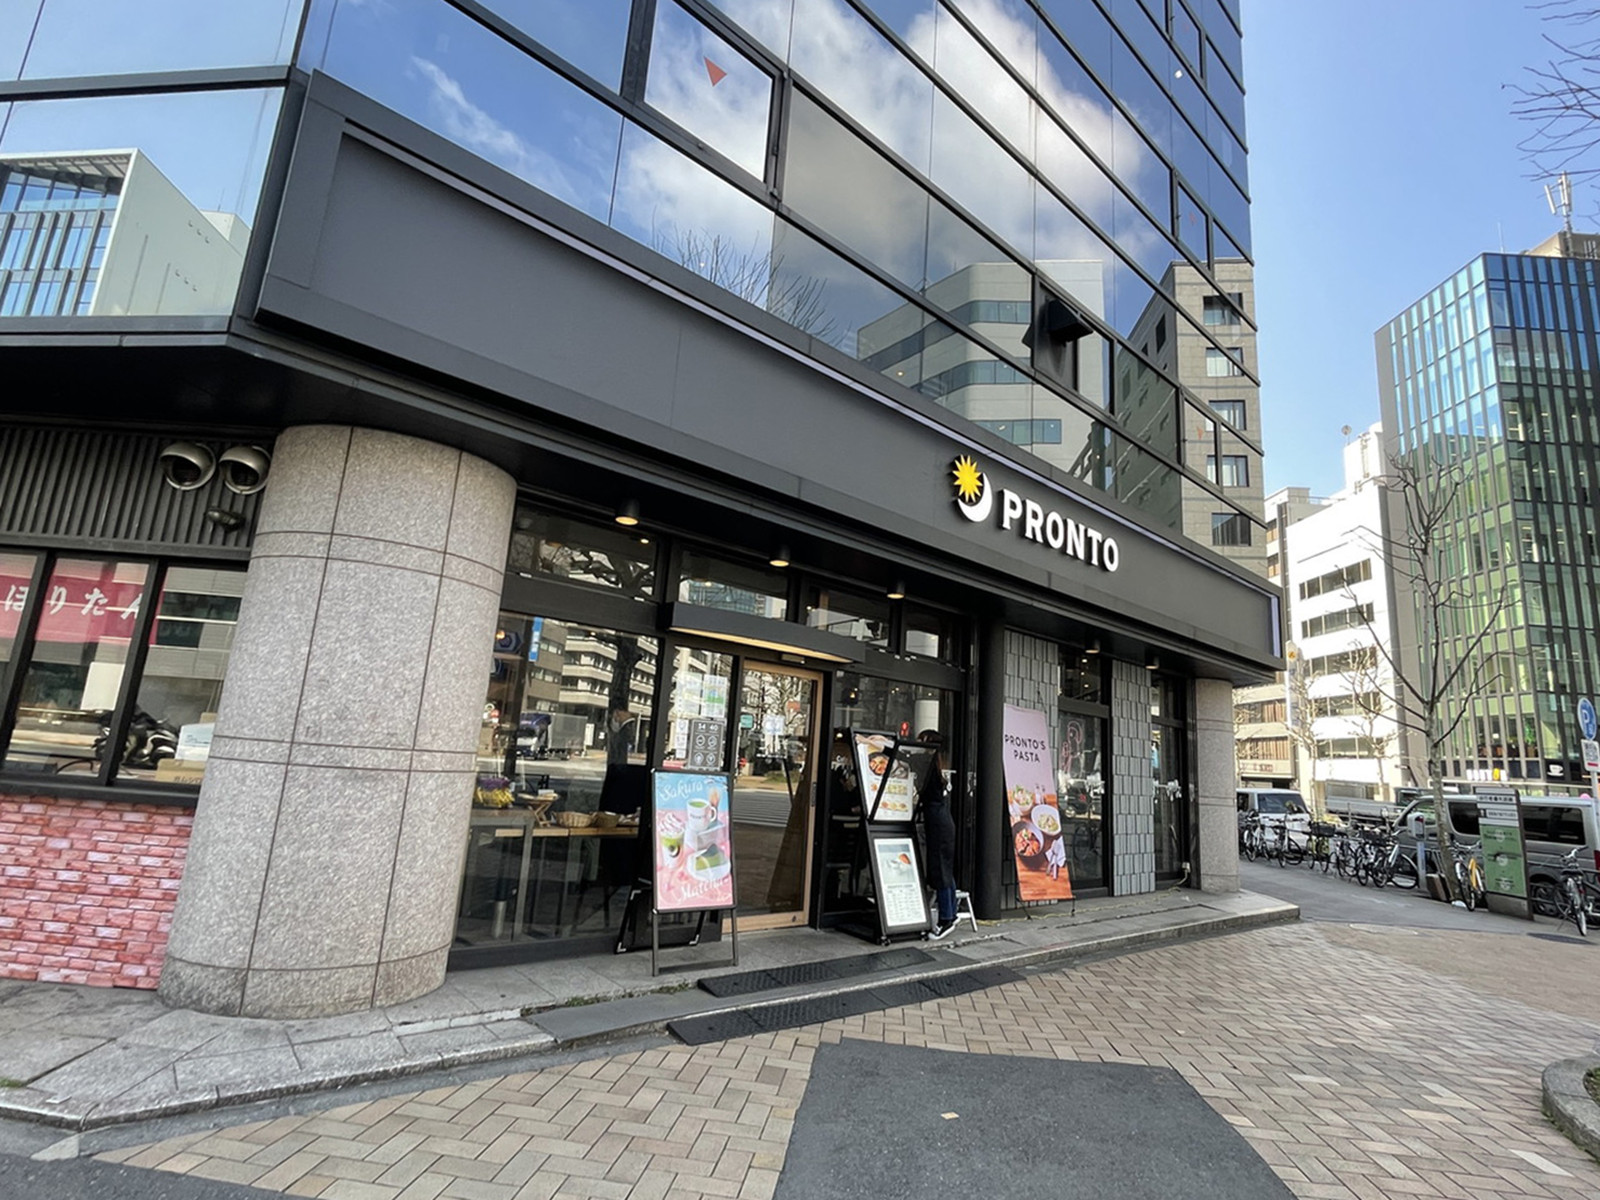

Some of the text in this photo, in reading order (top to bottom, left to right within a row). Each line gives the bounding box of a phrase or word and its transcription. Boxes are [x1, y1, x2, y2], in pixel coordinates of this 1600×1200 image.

[1001, 487, 1119, 572] PRONTO
[1004, 733, 1047, 751] PRONTO'S
[1013, 749, 1041, 763] PASTA
[658, 780, 704, 801] Sakura
[677, 878, 728, 903] Matcha
